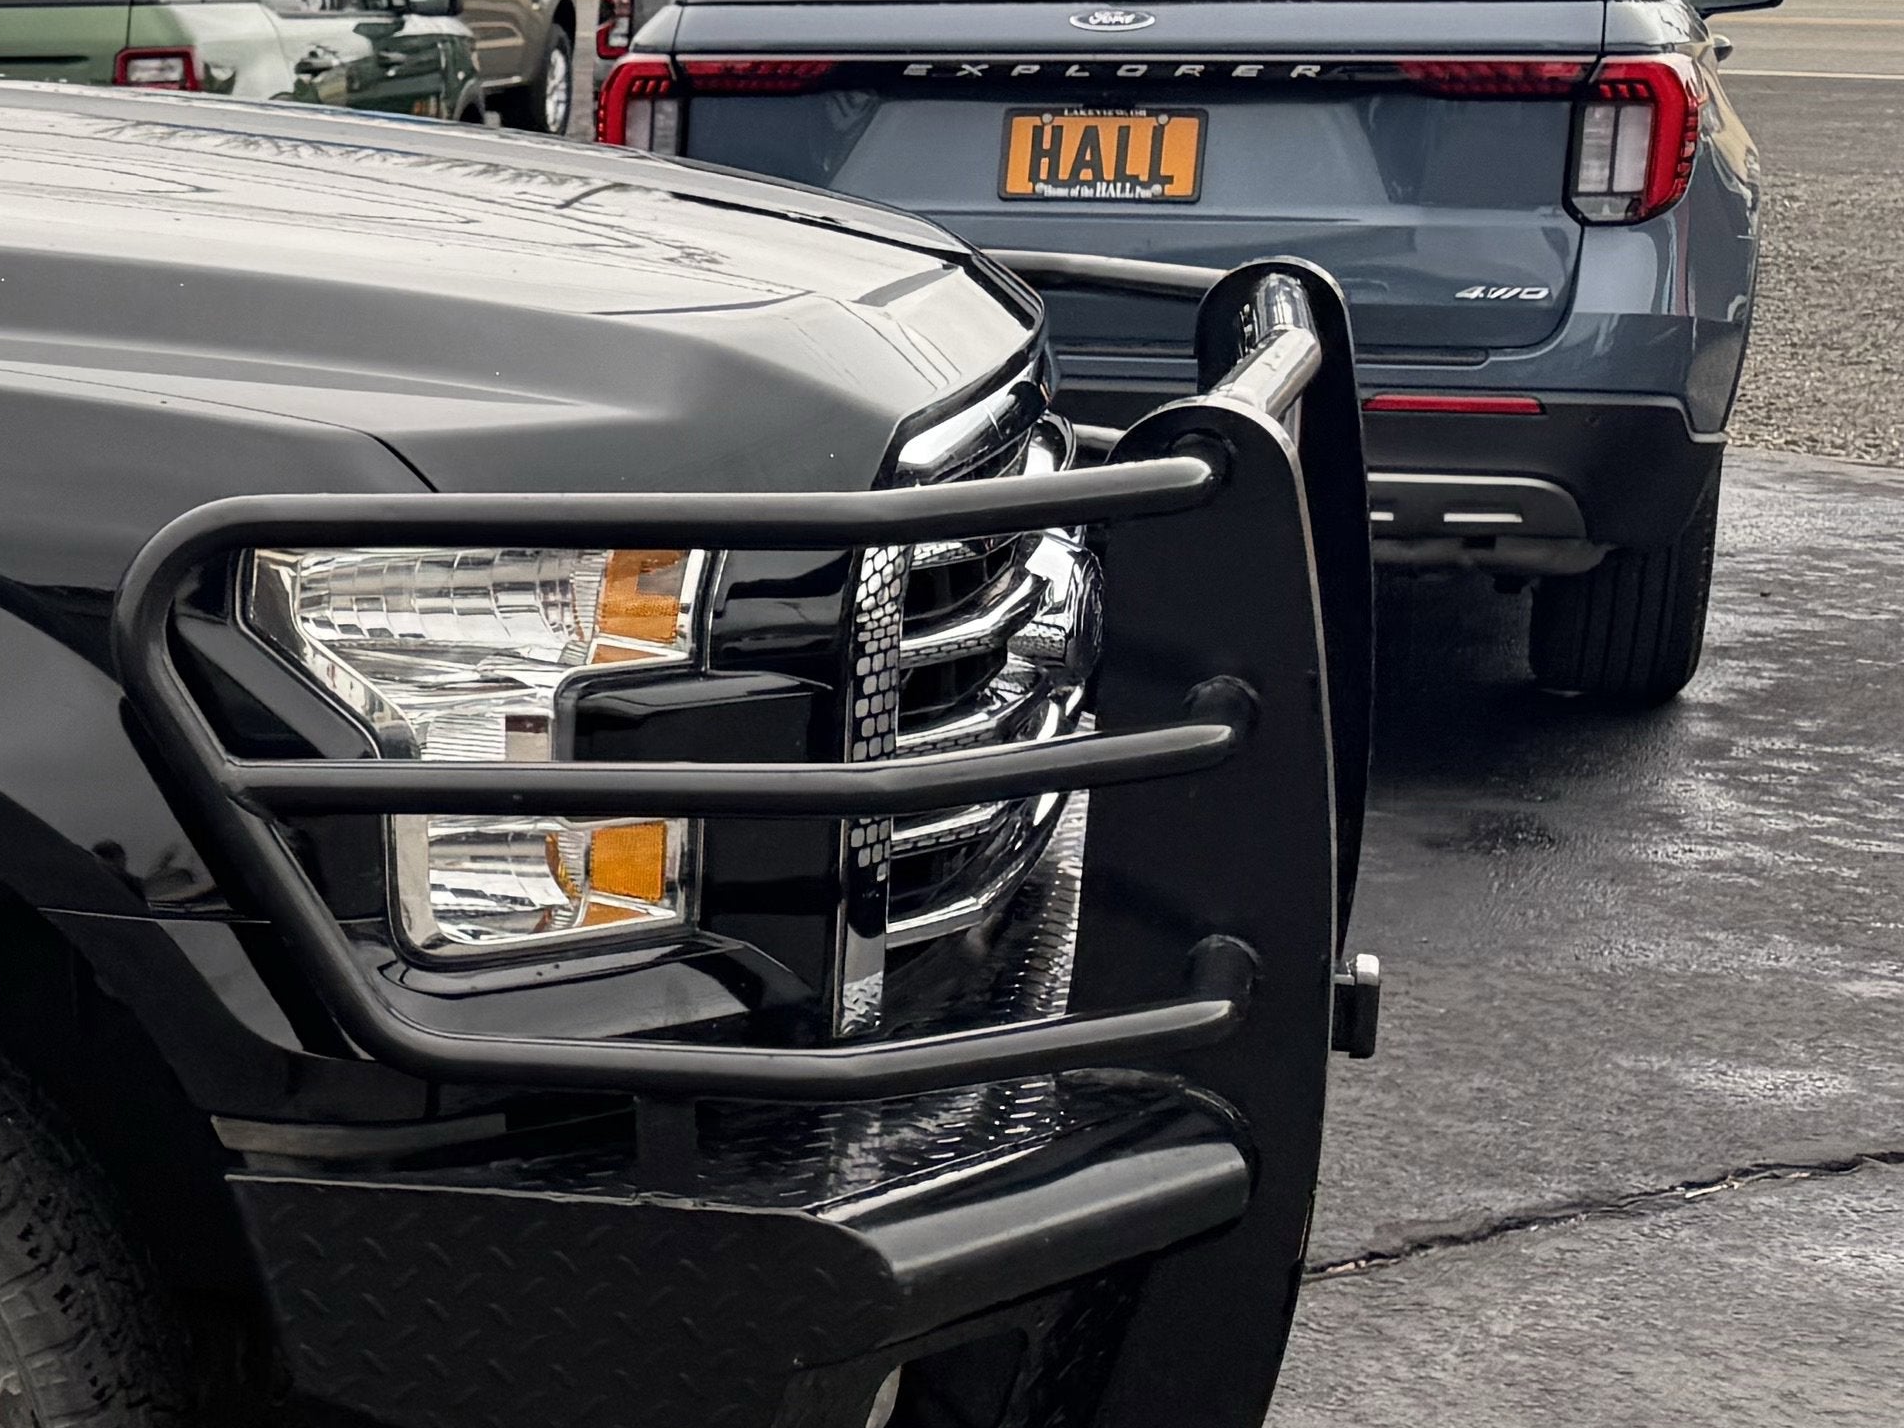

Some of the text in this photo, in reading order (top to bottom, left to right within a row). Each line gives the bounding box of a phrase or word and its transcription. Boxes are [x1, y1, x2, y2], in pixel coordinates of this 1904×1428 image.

[903, 65, 1322, 78] EXPLORER
[1028, 125, 1174, 185] HALL
[1095, 181, 1134, 199] HALL
[1455, 286, 1549, 300] 4WD
